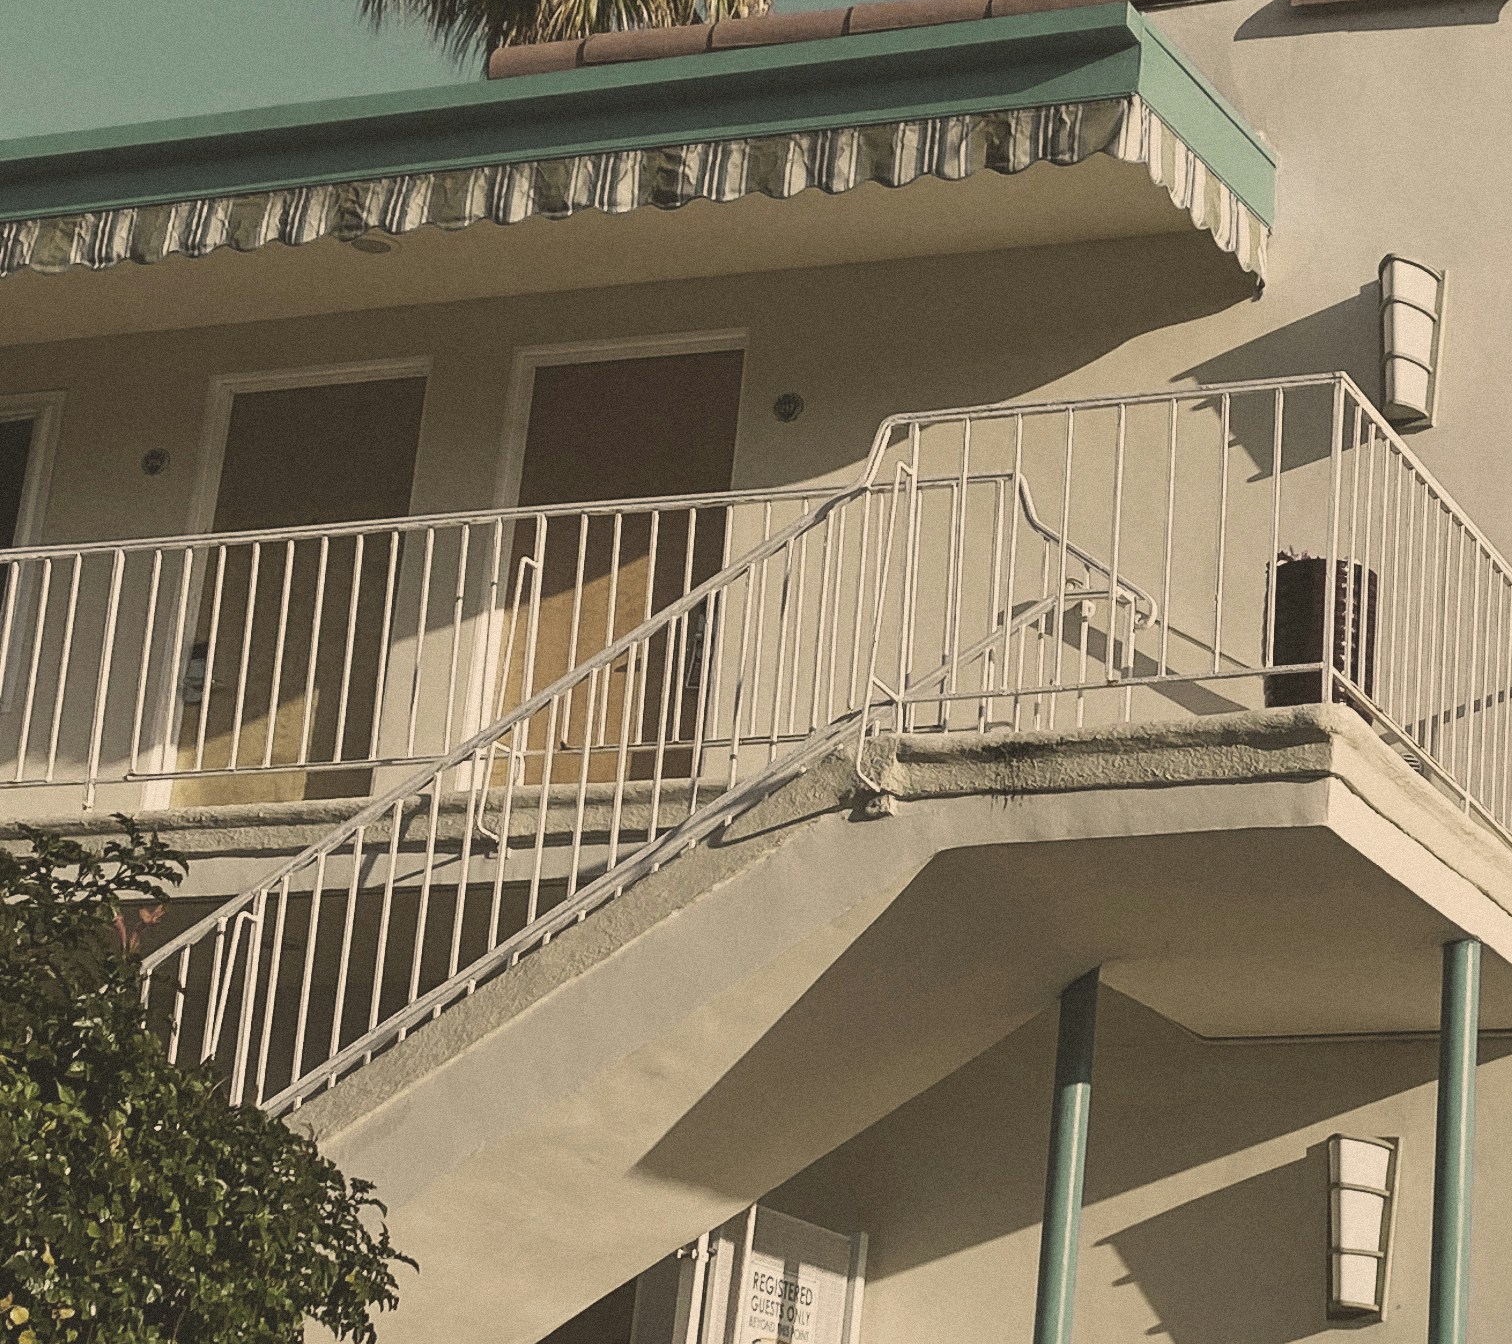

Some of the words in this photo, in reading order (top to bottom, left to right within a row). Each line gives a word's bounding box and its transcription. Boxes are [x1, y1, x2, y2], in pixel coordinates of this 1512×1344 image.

[753, 1272, 812, 1305] REGISTERED
[752, 1295, 784, 1318] GUESTS
[787, 1306, 810, 1326] ONLY
